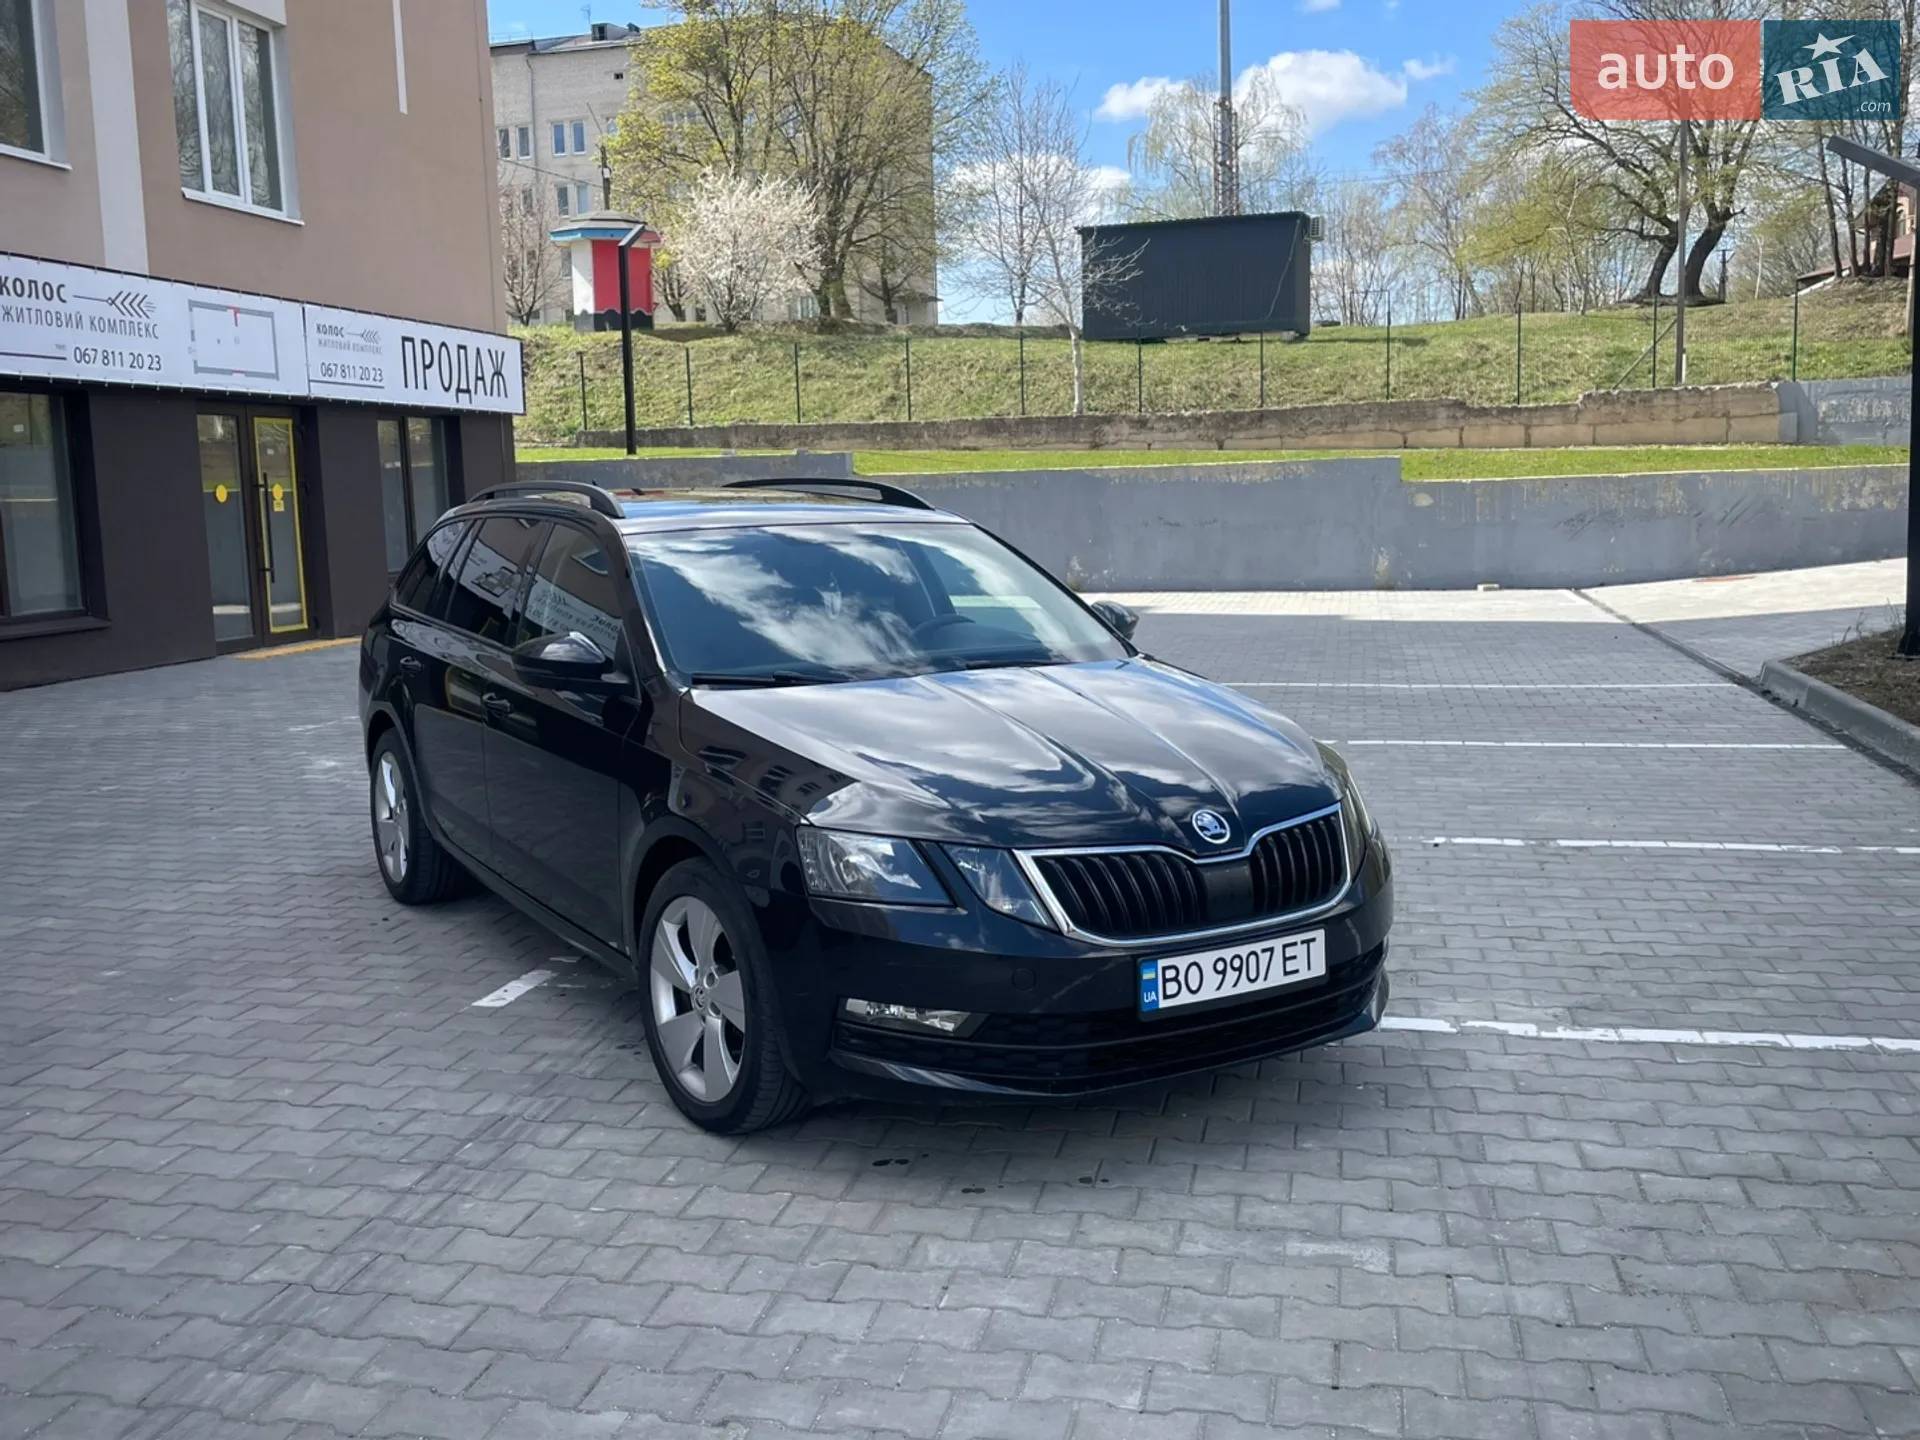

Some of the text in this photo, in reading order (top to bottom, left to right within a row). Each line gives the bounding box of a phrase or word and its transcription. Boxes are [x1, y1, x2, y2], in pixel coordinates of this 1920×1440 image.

[1, 304, 159, 339] ЖИТЛОВИЙ КОМПЛЕКС
[73, 346, 98, 364] 067
[101, 349, 124, 367] 811
[128, 352, 145, 369] 20
[146, 354, 162, 371] 23
[320, 362, 384, 382] 067 811 20 23
[401, 335, 508, 404] ПРОДАЖ
[1161, 937, 1317, 1001] BO 9907 ET
[1143, 991, 1157, 1003] UA
